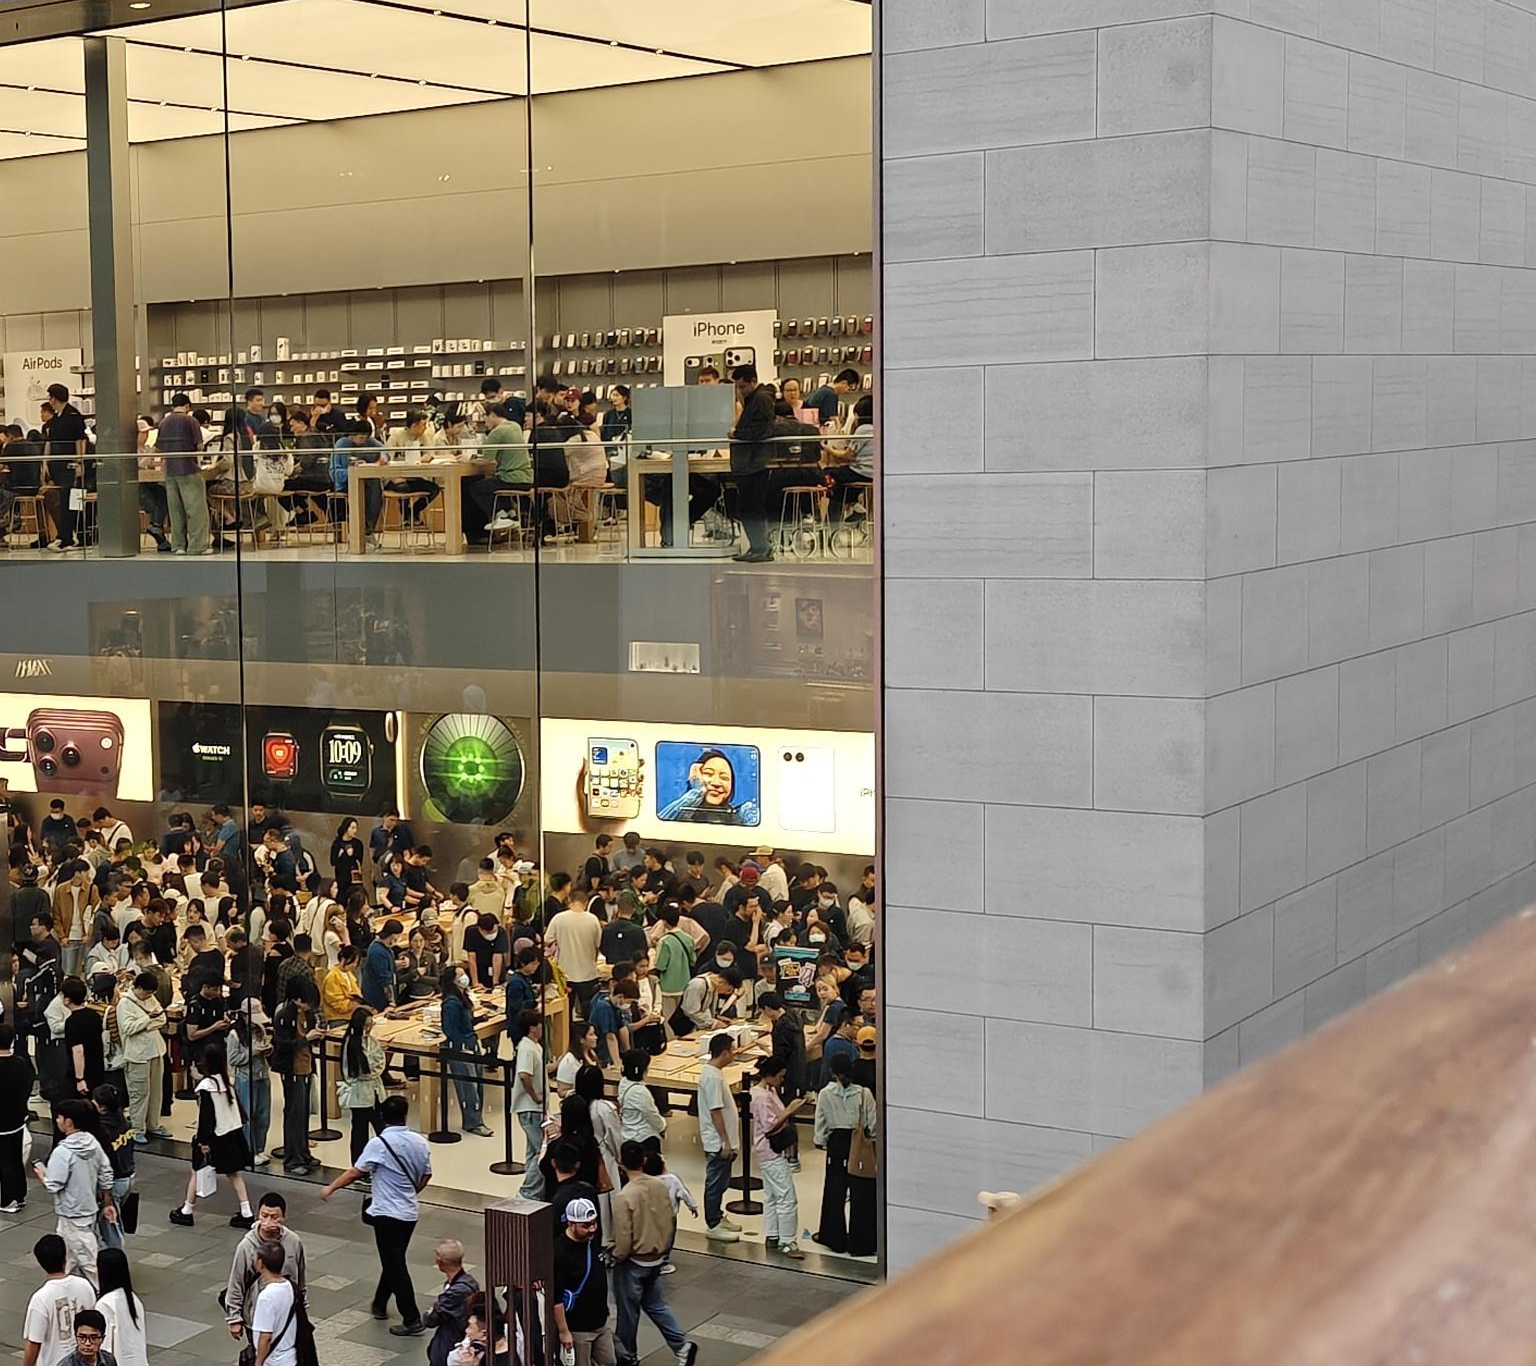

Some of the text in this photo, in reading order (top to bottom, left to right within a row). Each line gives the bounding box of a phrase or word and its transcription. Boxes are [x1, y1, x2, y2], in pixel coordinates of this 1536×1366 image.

[693, 321, 745, 337] iPhone
[22, 356, 63, 370] AirPods
[199, 745, 231, 755] WATCH
